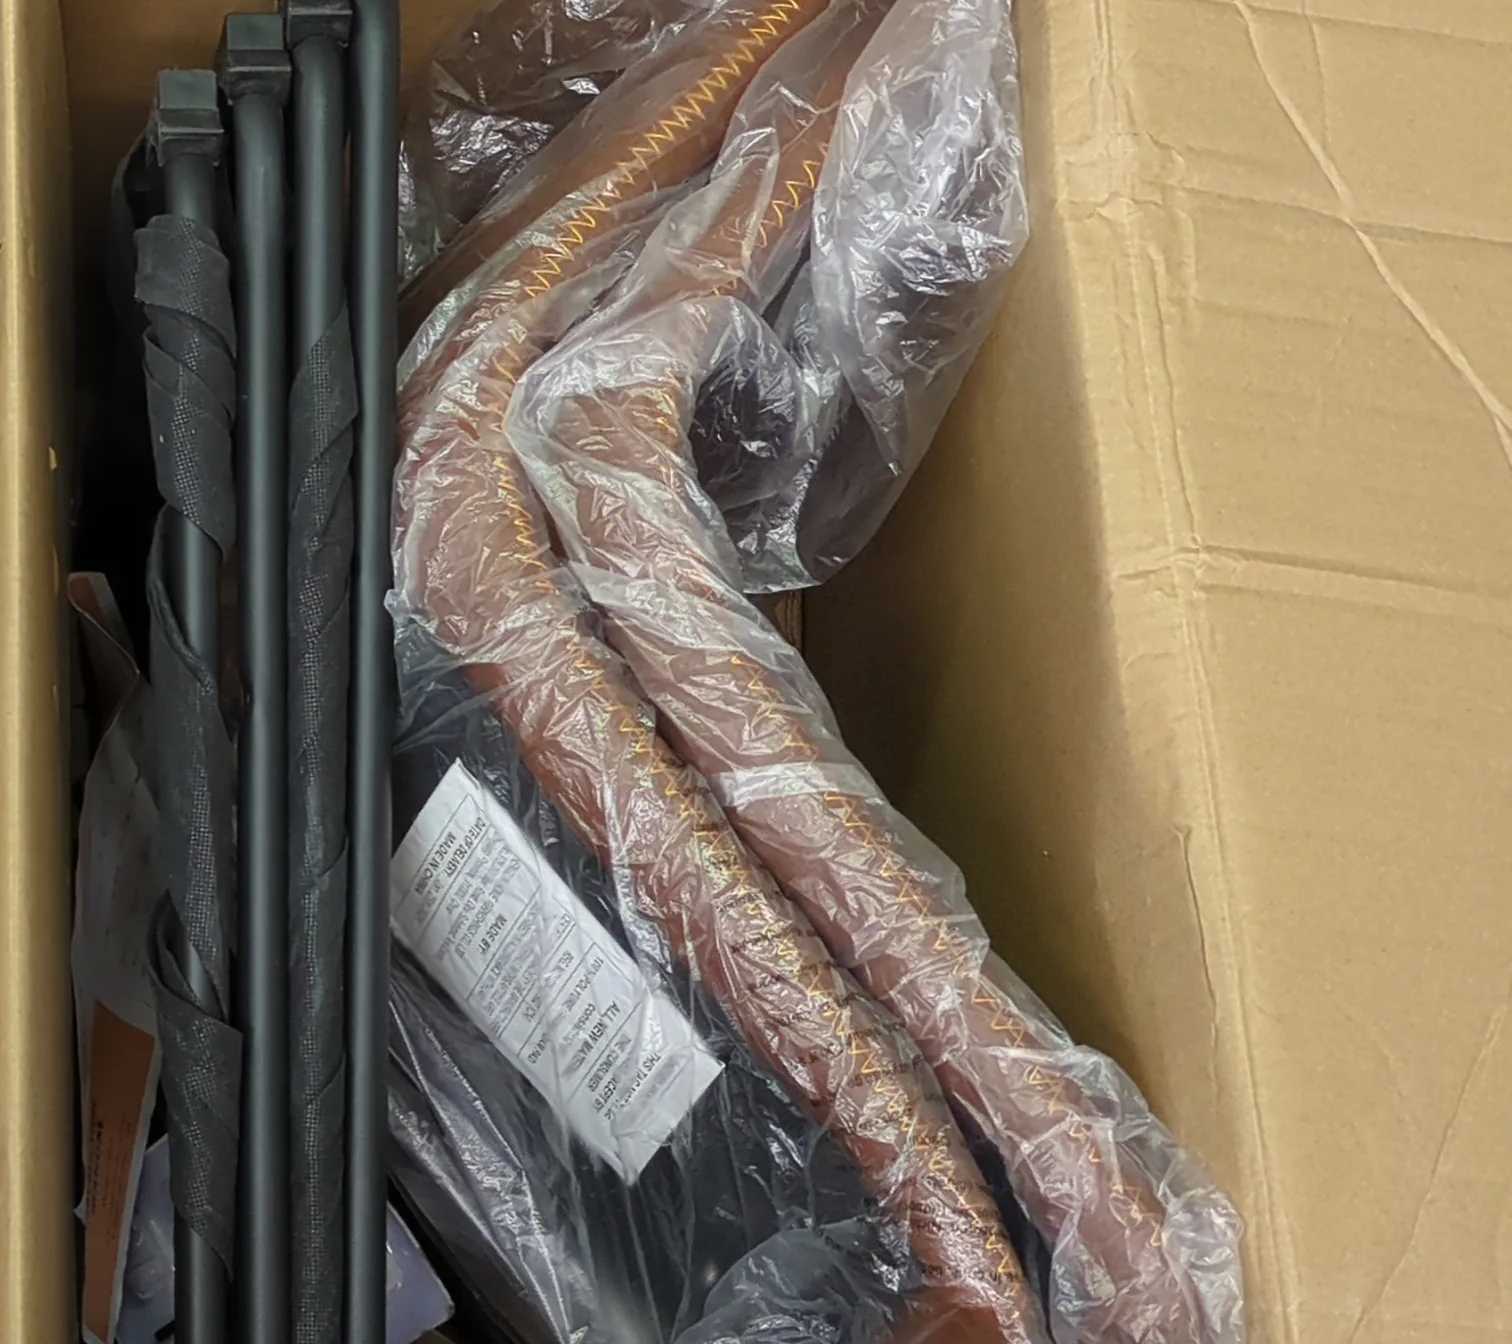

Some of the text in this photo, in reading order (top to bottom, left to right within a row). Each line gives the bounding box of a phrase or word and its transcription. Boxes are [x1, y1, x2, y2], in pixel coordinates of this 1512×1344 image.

[469, 816, 485, 839] DATE
[435, 831, 455, 860] MADE
[428, 856, 440, 870] IN
[485, 912, 506, 941] MADE
[603, 999, 621, 1023] ALL
